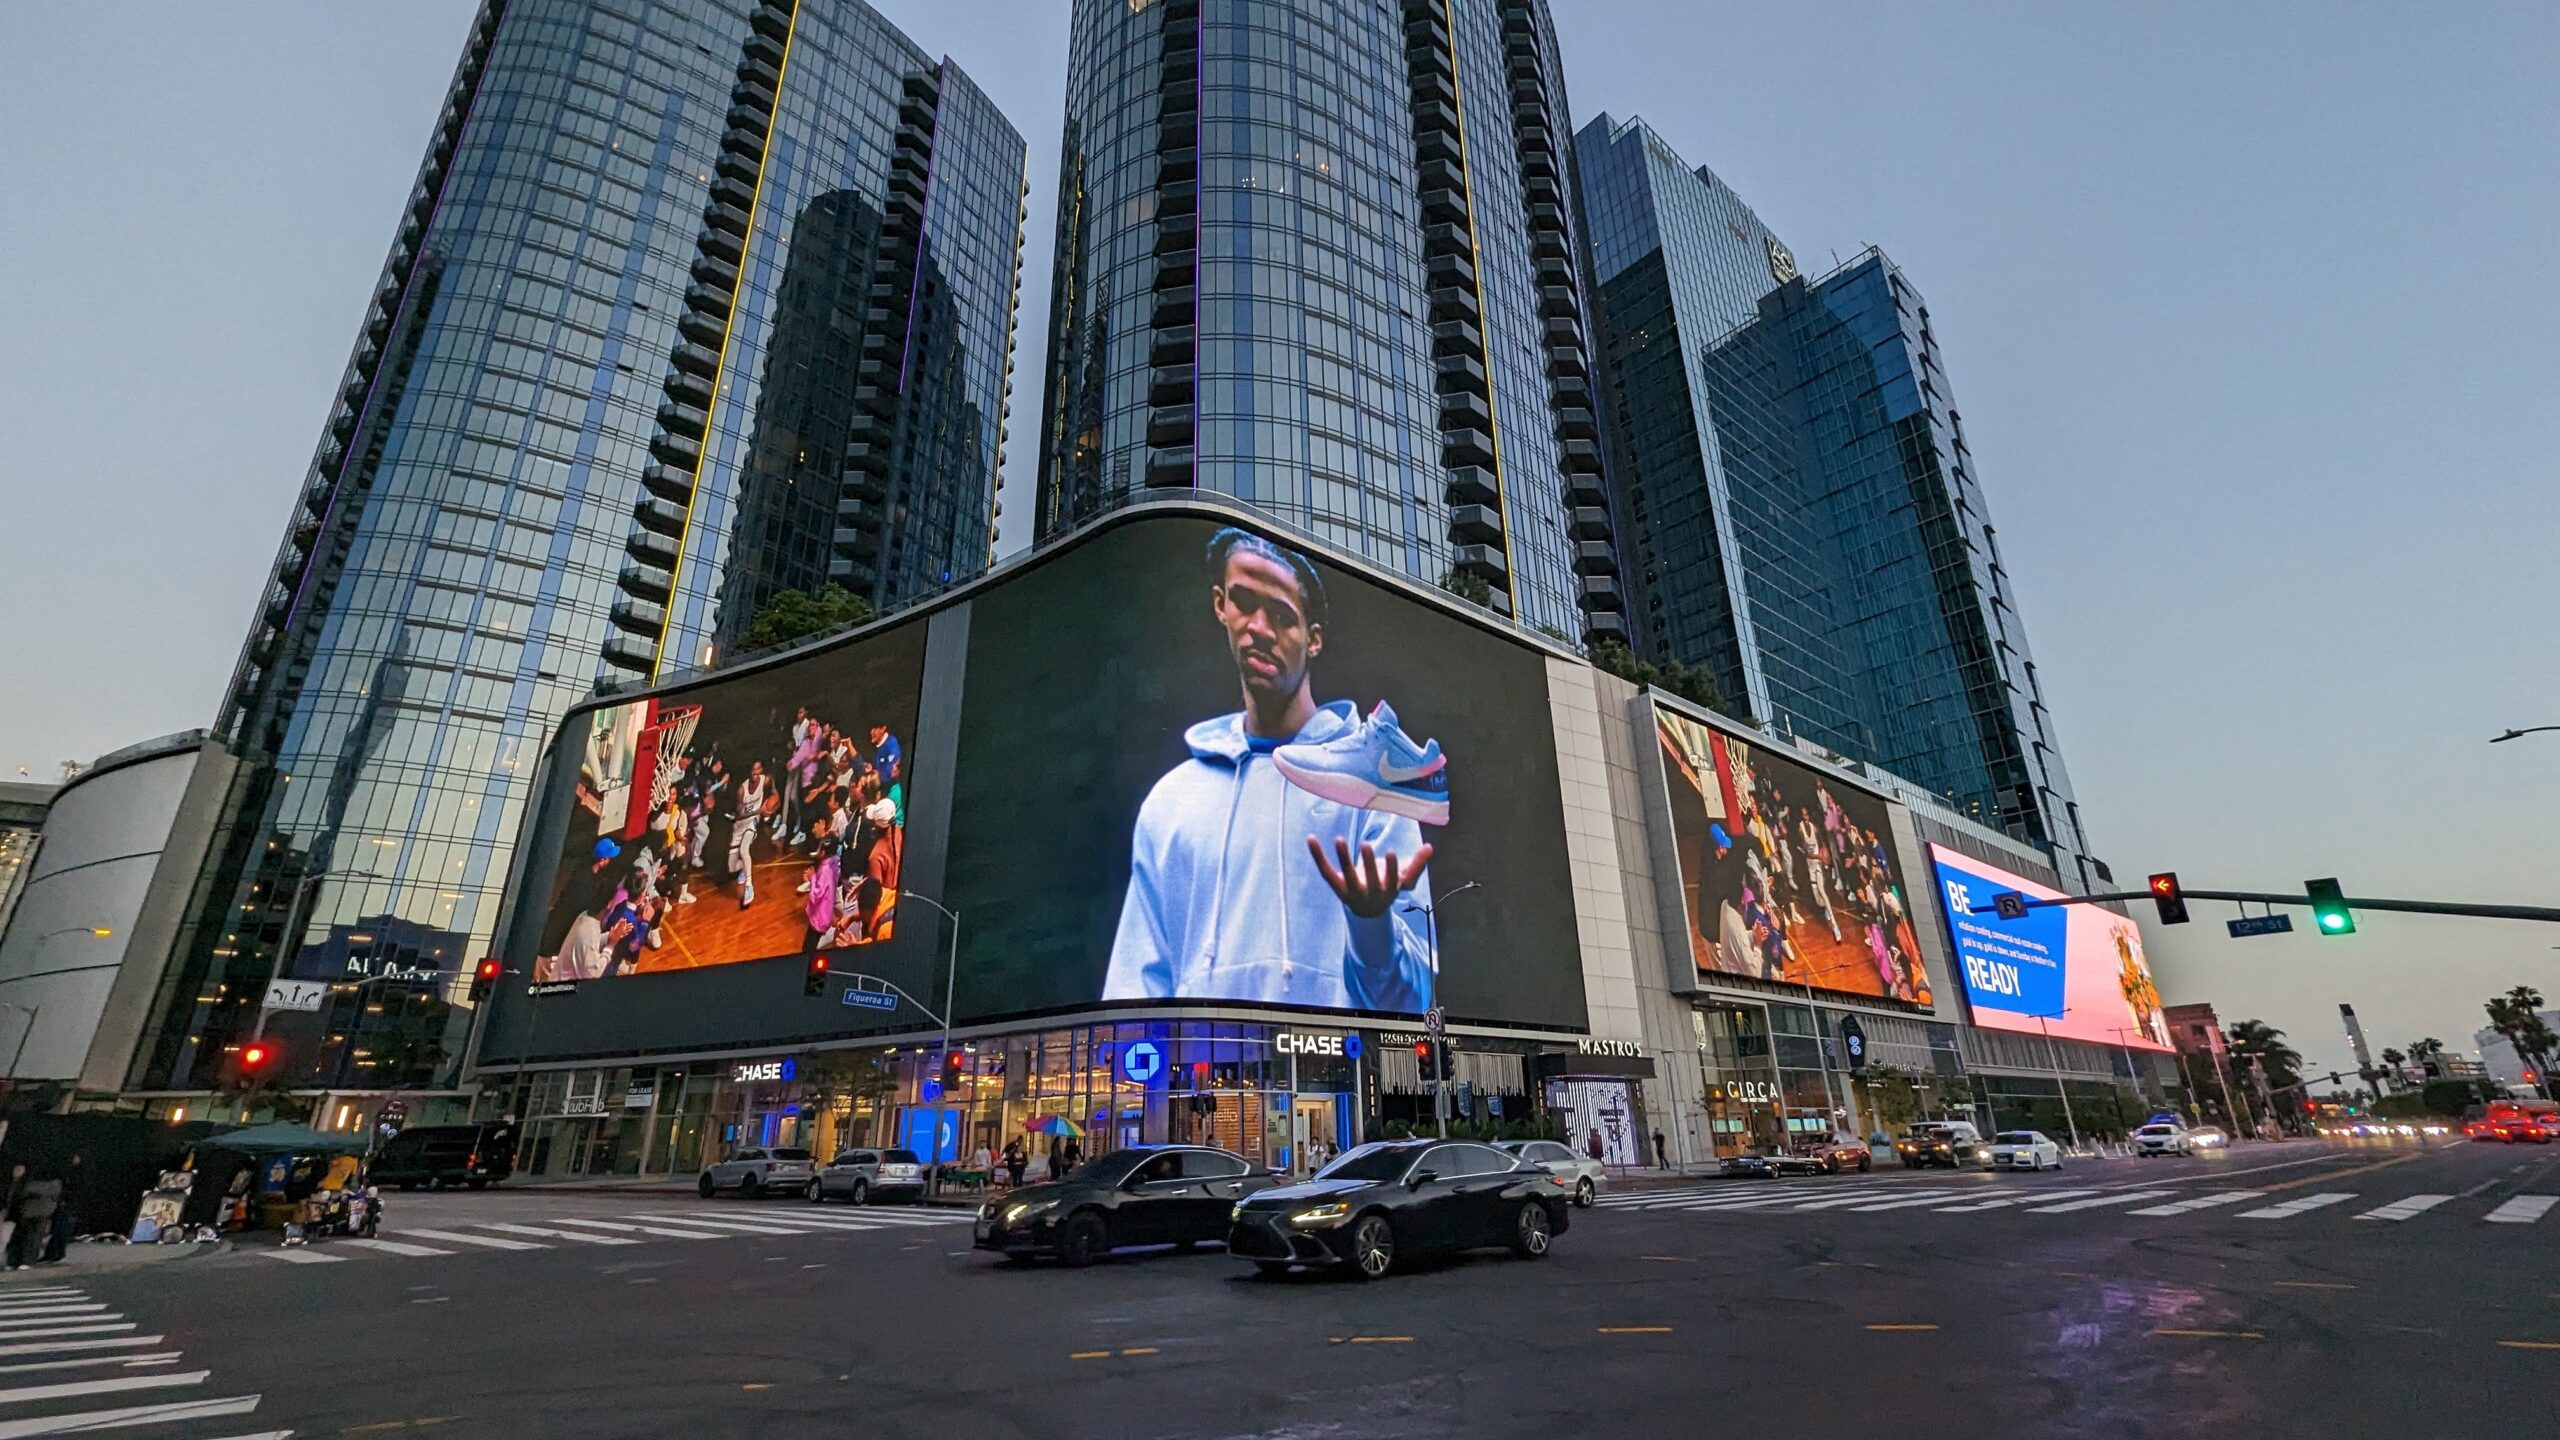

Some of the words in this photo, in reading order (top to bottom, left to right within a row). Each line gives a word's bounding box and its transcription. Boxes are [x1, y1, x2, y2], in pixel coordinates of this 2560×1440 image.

[1946, 880, 1975, 916] BE
[1965, 955, 2021, 996] READY
[848, 992, 882, 1004] Figueroa
[883, 996, 893, 1006] St
[1276, 1033, 1344, 1056] CHASE
[1578, 1038, 1642, 1058] MASTRO'S
[1727, 1080, 1779, 1098] CIRCA
